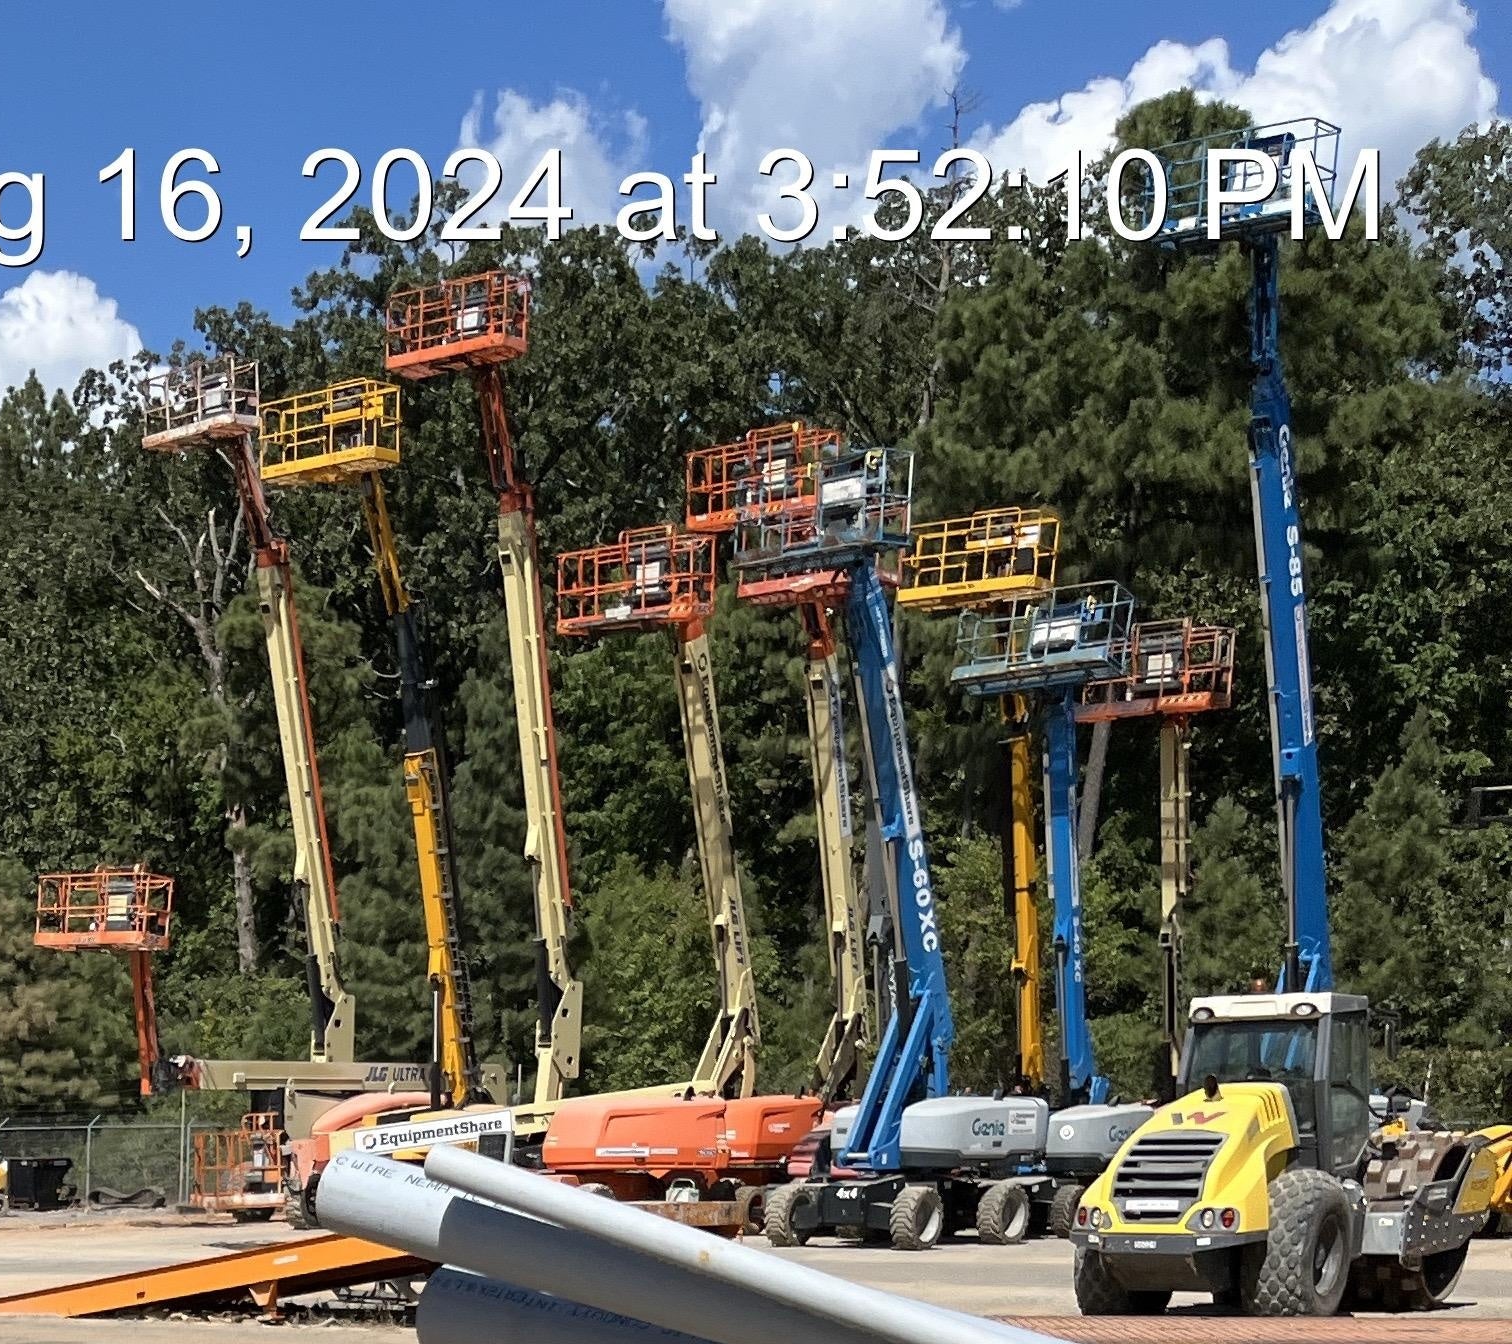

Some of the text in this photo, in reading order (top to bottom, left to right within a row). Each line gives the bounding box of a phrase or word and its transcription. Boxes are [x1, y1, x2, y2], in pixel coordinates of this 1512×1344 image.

[888, 693, 914, 826] EquipmentShare
[365, 1066, 426, 1082] JLG ULTRA
[379, 1119, 503, 1147] EquipmentShare
[972, 1117, 1005, 1137] Genie
[350, 1160, 393, 1179] WIRE
[836, 1187, 859, 1199] 4x4
